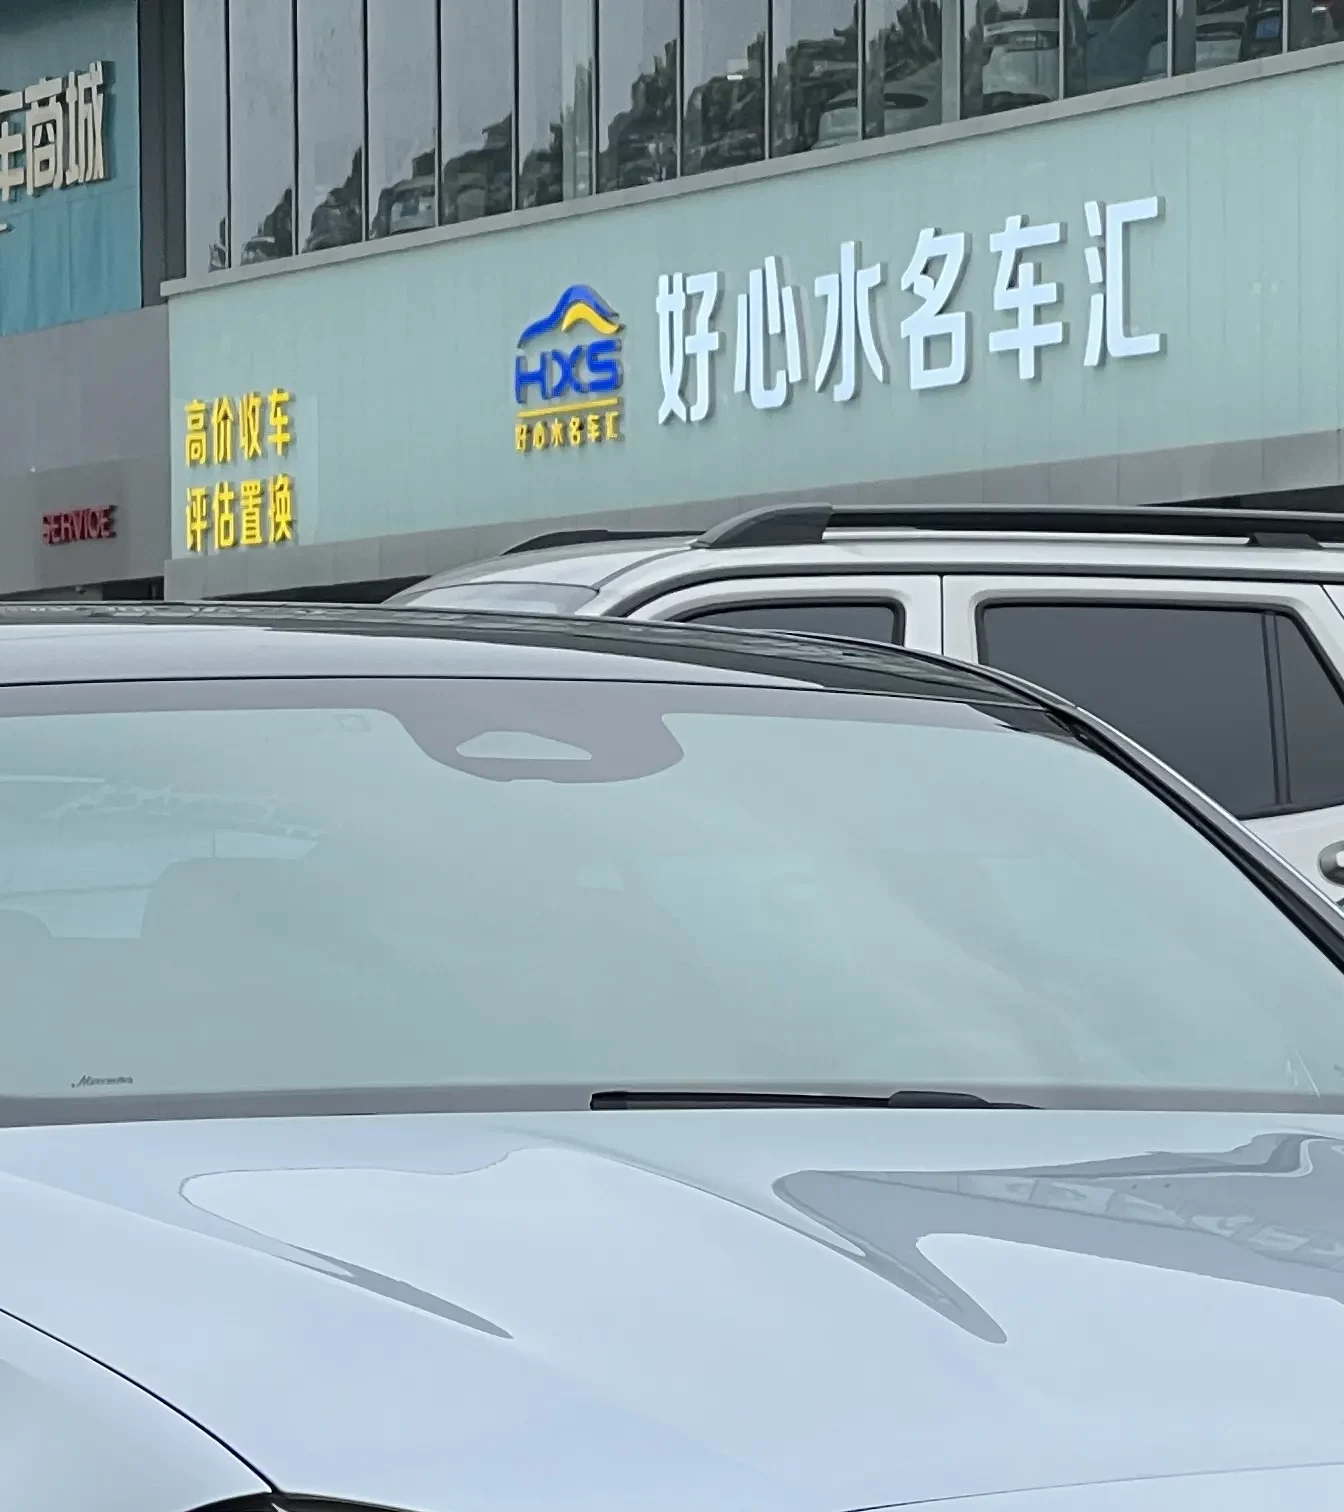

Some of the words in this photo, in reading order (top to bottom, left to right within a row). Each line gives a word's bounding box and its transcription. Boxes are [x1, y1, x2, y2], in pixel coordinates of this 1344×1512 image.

[657, 196, 1161, 425] 好心水名车汇
[514, 338, 621, 405] HXS
[184, 387, 291, 467] 高价收车
[42, 505, 112, 545] SERVICE
[185, 473, 293, 553] 评估置换
